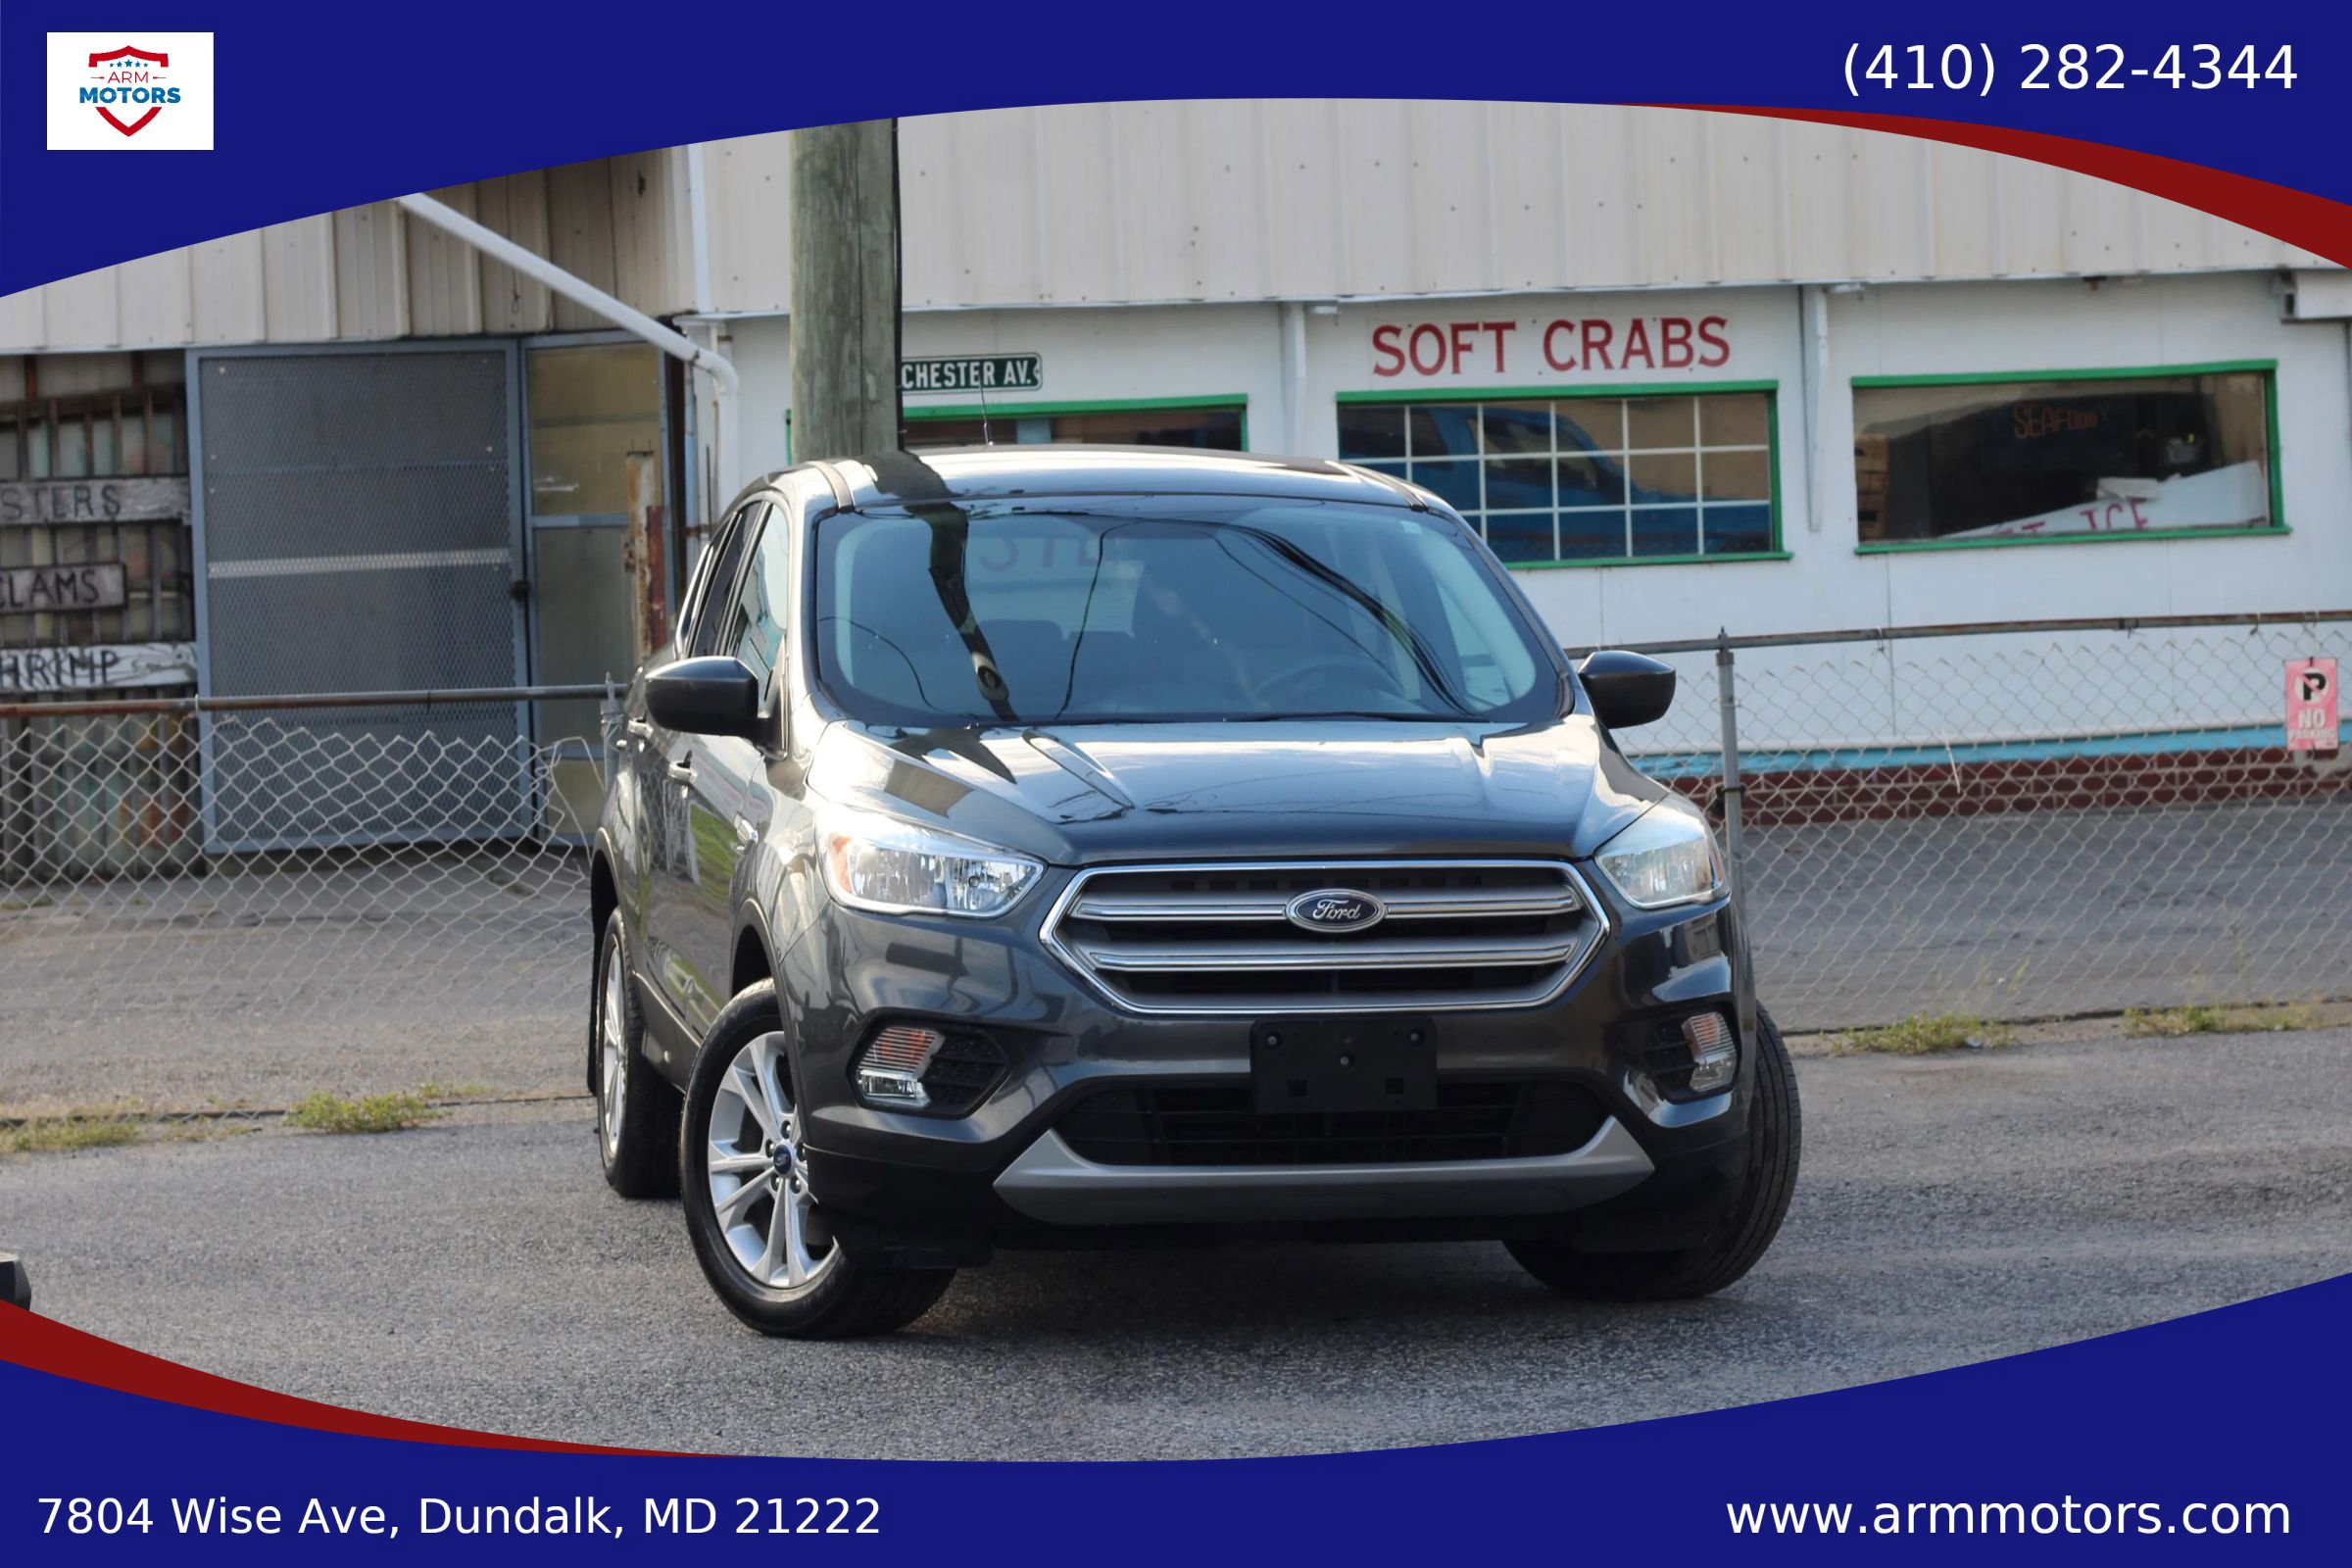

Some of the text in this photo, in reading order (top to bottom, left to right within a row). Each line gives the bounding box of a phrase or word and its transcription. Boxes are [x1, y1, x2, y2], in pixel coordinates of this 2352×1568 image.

[1372, 316, 1731, 377] SOFT CRABS
[902, 360, 1032, 389] CHESTER AV.
[2298, 709, 2327, 729] NO
[1312, 899, 1361, 920] Ford
